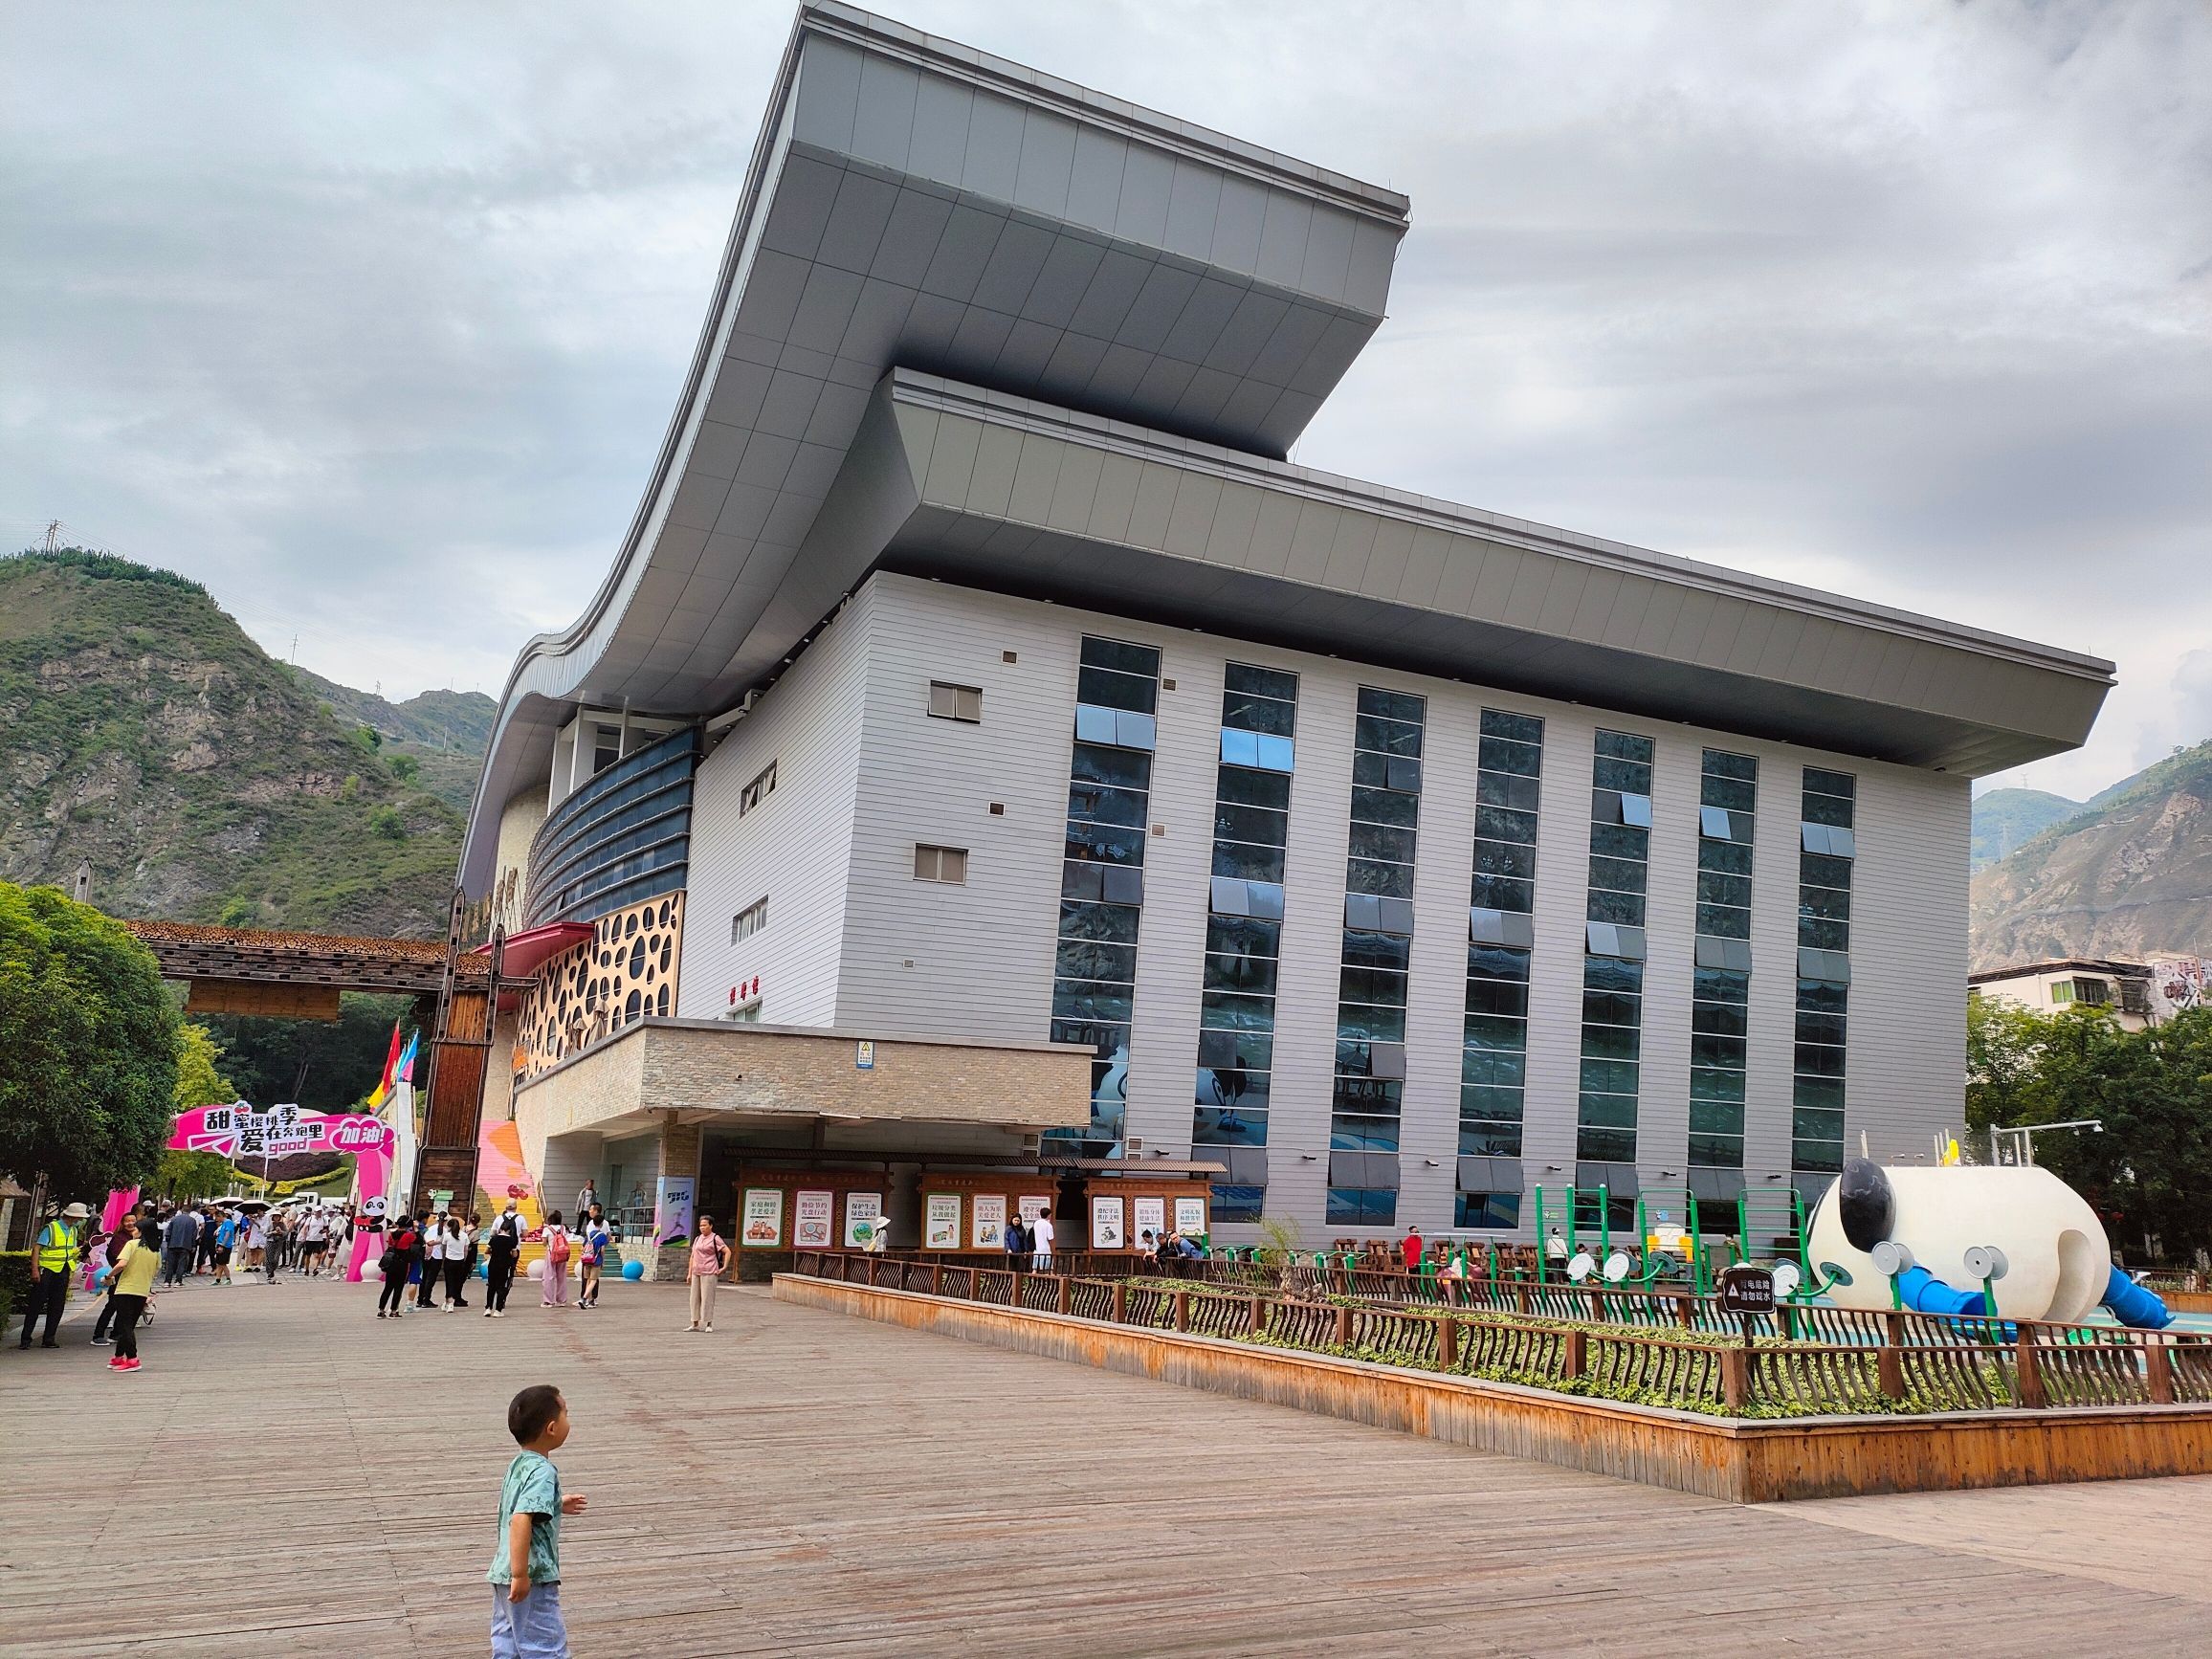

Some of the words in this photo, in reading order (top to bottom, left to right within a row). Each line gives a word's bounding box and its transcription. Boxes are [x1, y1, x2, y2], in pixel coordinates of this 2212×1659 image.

[207, 1106, 299, 1129] 甜蜜樱桃季
[241, 1124, 323, 1152] 爱在奔跑里
[268, 1139, 307, 1156] good
[1740, 1291, 1771, 1301] 请勿戏水
